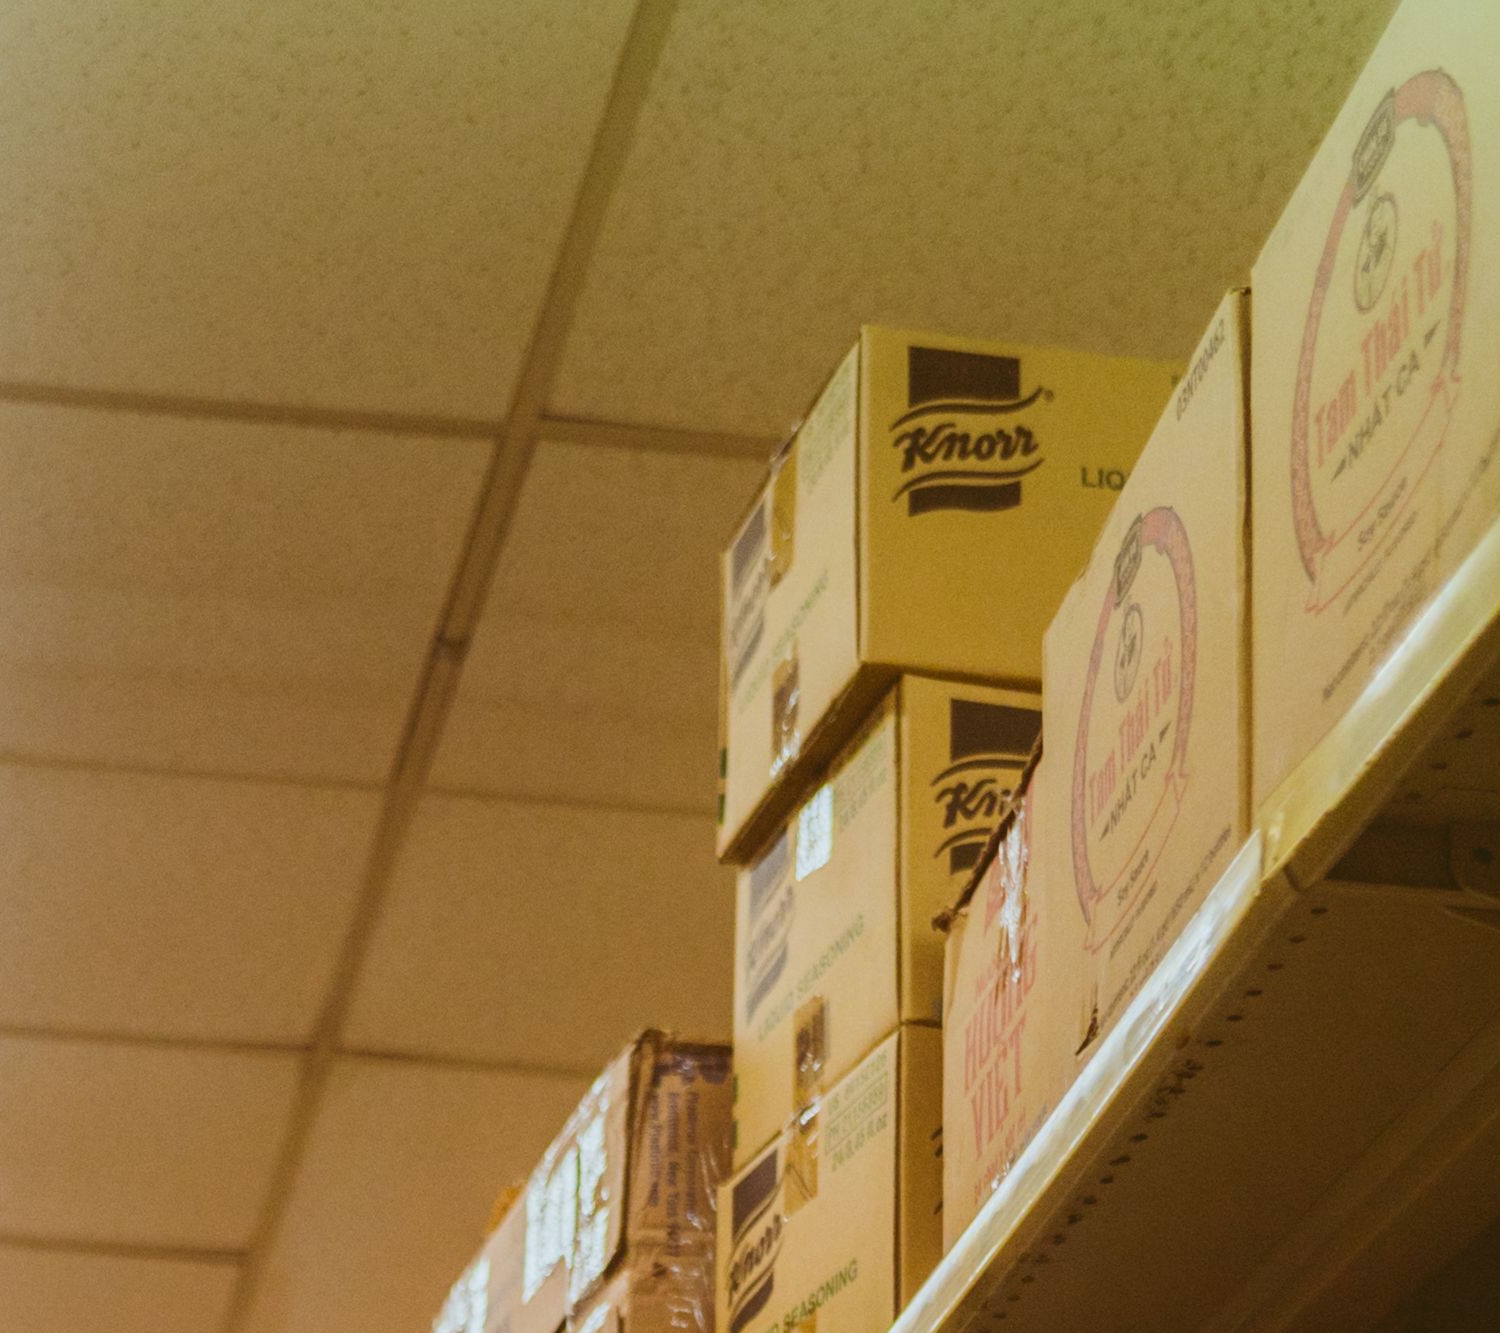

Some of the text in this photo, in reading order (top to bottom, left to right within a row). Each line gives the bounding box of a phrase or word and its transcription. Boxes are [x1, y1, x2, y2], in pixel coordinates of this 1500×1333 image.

[893, 421, 1040, 474] Knorr
[934, 777, 1013, 829] Kn
[782, 1256, 859, 1333] SEASONING
